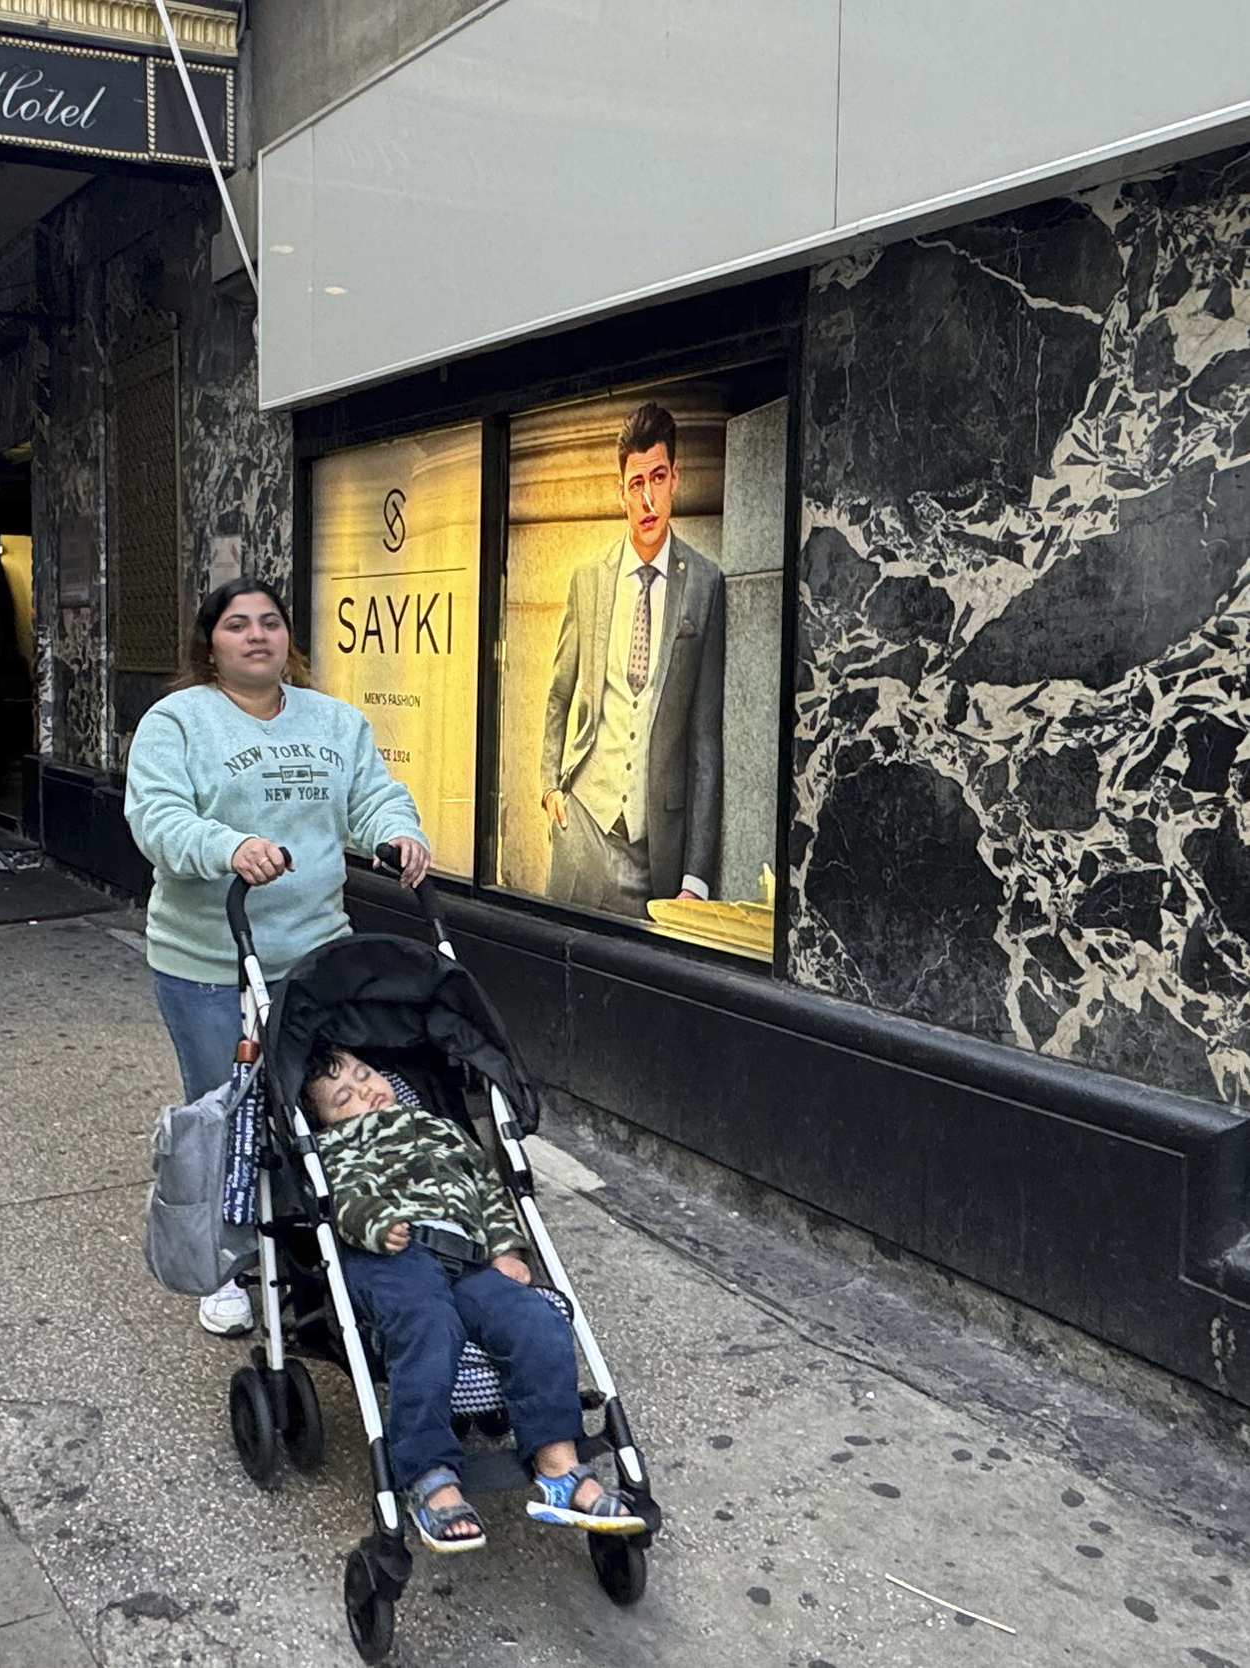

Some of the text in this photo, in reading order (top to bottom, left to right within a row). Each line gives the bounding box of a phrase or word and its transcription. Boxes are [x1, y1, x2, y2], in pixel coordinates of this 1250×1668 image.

[337, 592, 453, 656] SAYKI
[364, 692, 421, 708] MEN'S FASHION
[224, 745, 264, 777] NEW
[267, 743, 316, 760] YORK
[393, 750, 411, 763] 1924
[264, 787, 330, 802] NEW YORK
